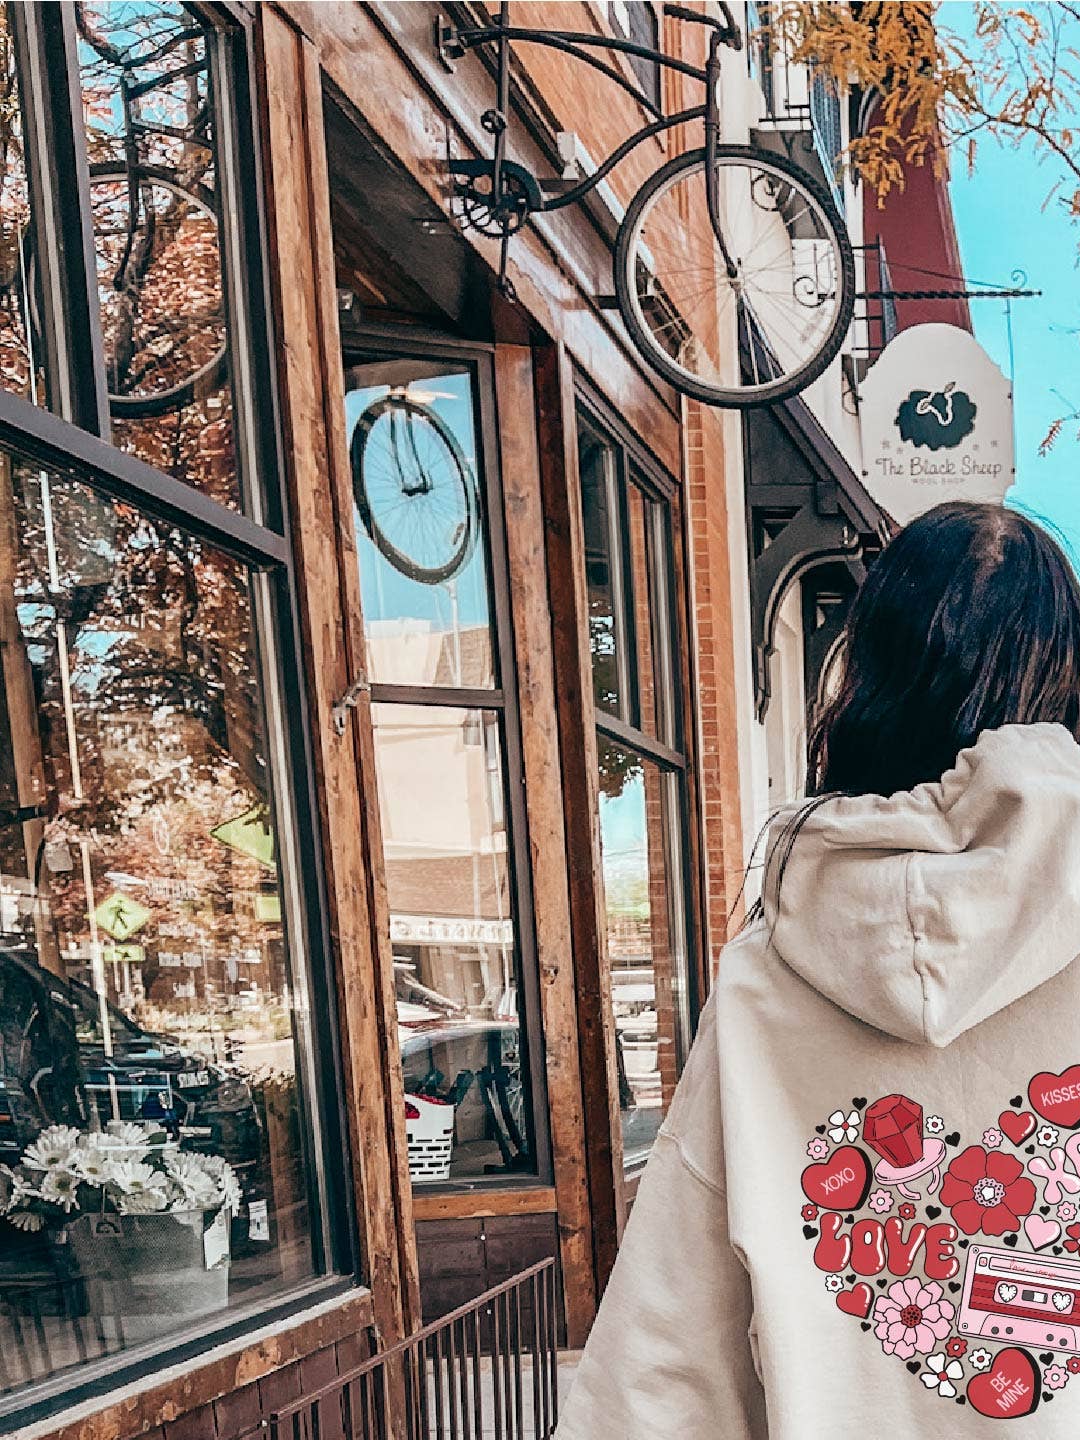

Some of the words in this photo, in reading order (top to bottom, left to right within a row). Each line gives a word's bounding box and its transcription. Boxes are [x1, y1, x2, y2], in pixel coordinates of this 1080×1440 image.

[875, 458, 904, 476] The
[910, 456, 956, 476] Black
[962, 454, 1002, 478] Sheep
[821, 1167, 855, 1195] XOXO
[813, 1212, 960, 1280] LOVE
[990, 1371, 1012, 1393] BE
[996, 1378, 1030, 1411] MINE
